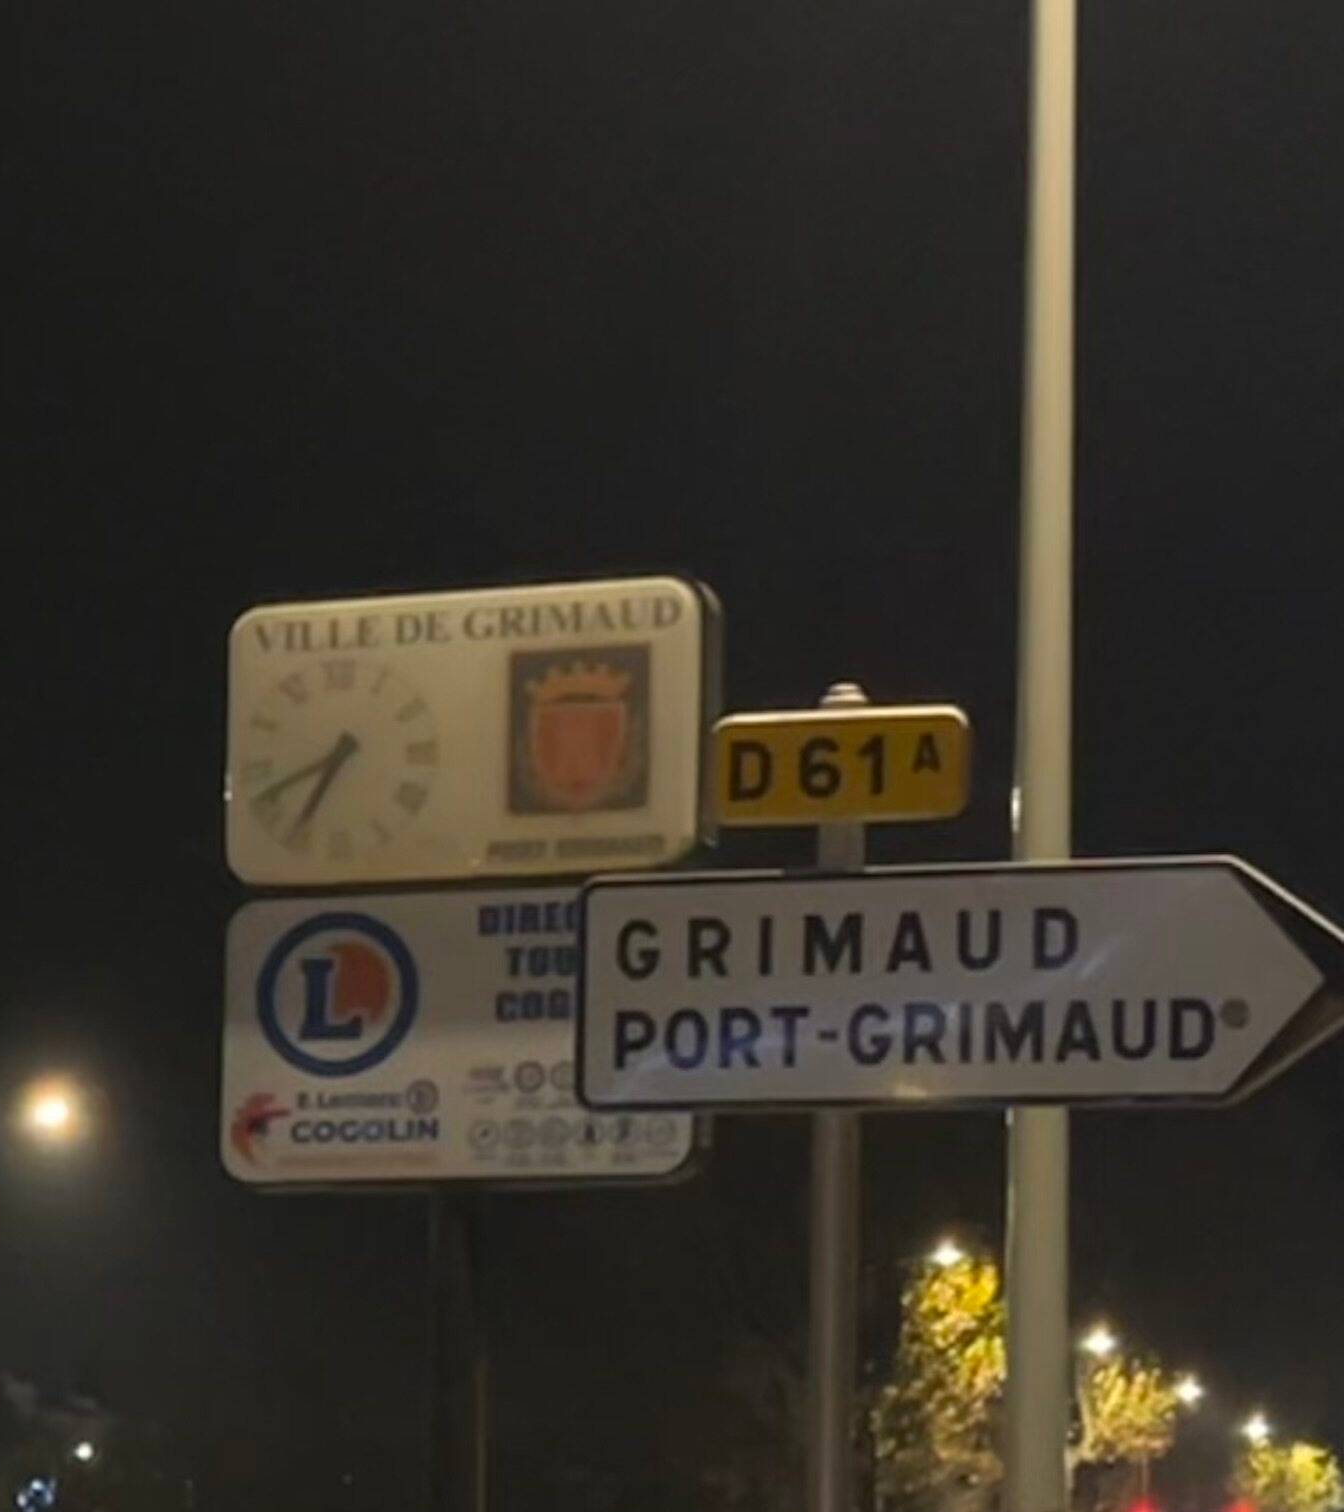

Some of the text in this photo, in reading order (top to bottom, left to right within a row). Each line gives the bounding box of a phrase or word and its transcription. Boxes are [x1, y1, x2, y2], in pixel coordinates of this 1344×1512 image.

[254, 597, 683, 654] VILLE DE GRIMAUD
[729, 741, 773, 801] D
[615, 907, 1079, 980] GRIMAUD
[612, 998, 1215, 1071] PORT-GRIMAUD
